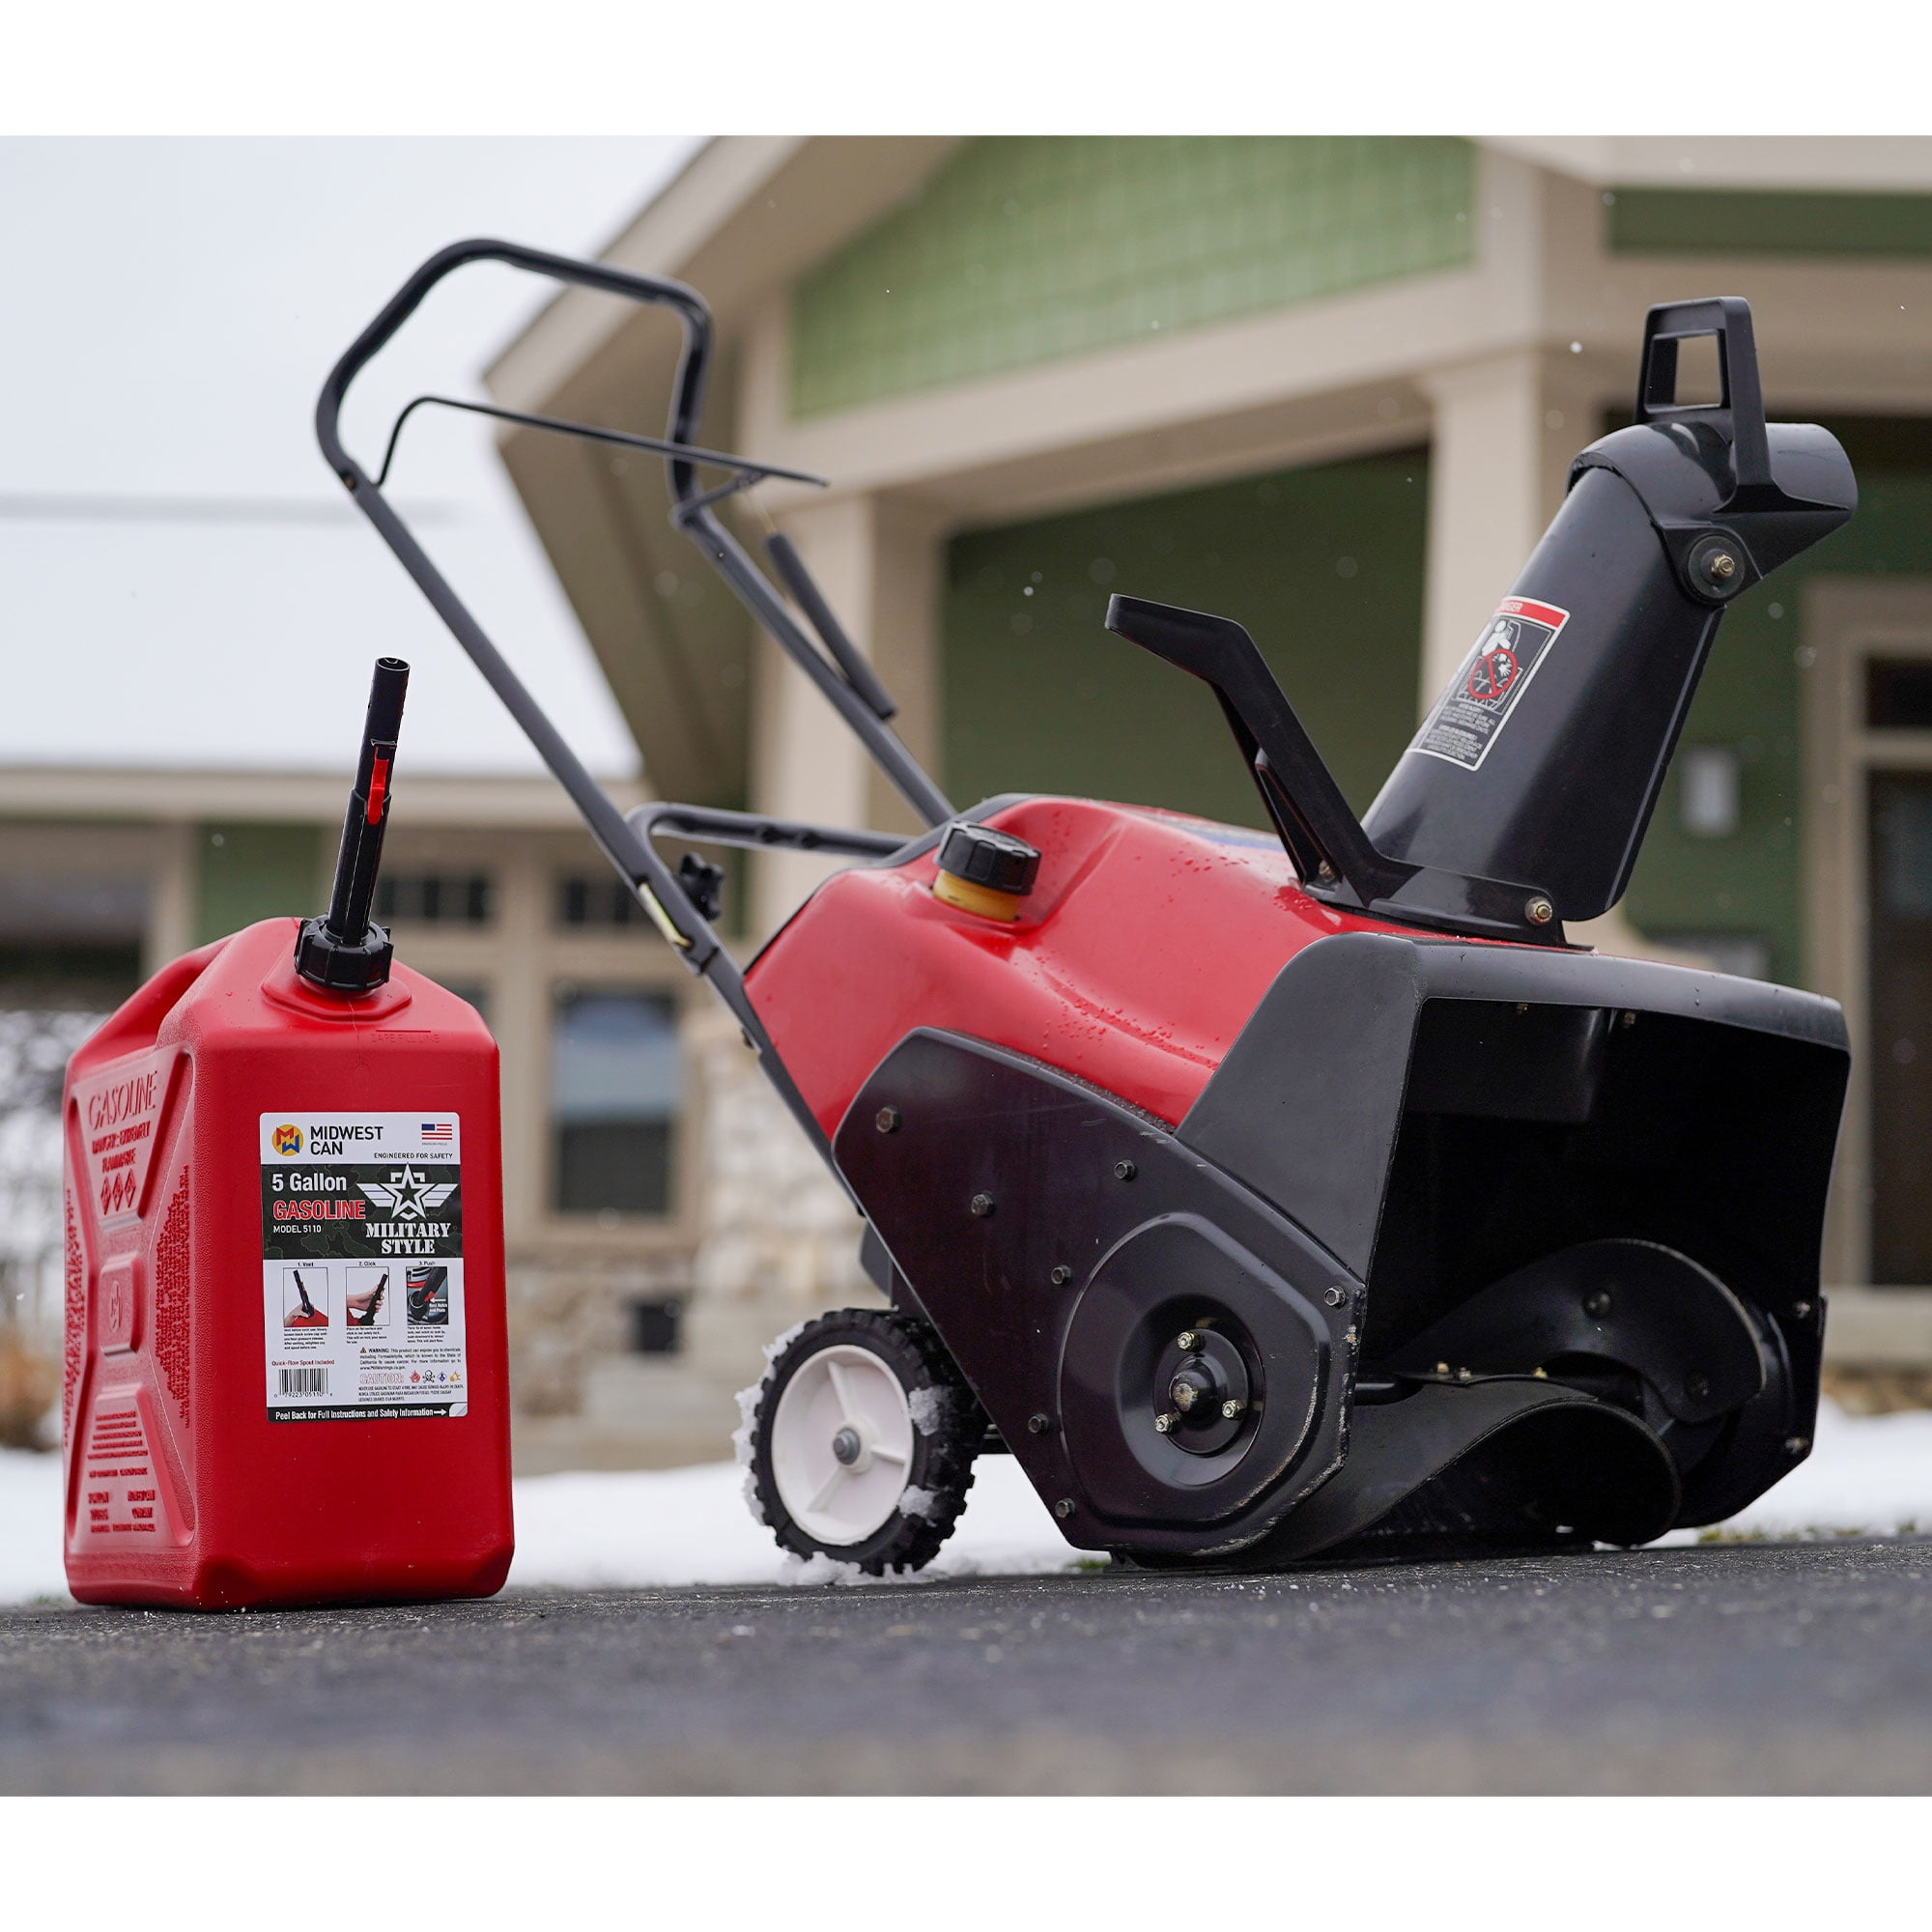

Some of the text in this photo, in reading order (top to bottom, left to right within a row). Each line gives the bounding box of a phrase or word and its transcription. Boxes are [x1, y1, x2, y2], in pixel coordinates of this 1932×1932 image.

[89, 1070, 157, 1131] GASOLINE
[310, 1125, 384, 1140] MIDWEST
[310, 1142, 343, 1155] CAN
[272, 1173, 347, 1191] 5 Gallon
[273, 1200, 366, 1220] GASOLINE
[365, 1223, 451, 1237] MILITARY
[382, 1239, 435, 1254] STYLE
[360, 1373, 404, 1384] CAUTION:
[275, 1411, 291, 1420] Peel
[317, 1410, 330, 1419] Full
[330, 1409, 366, 1418] Instructions
[380, 1408, 399, 1418] Safety
[399, 1407, 434, 1416] Information
